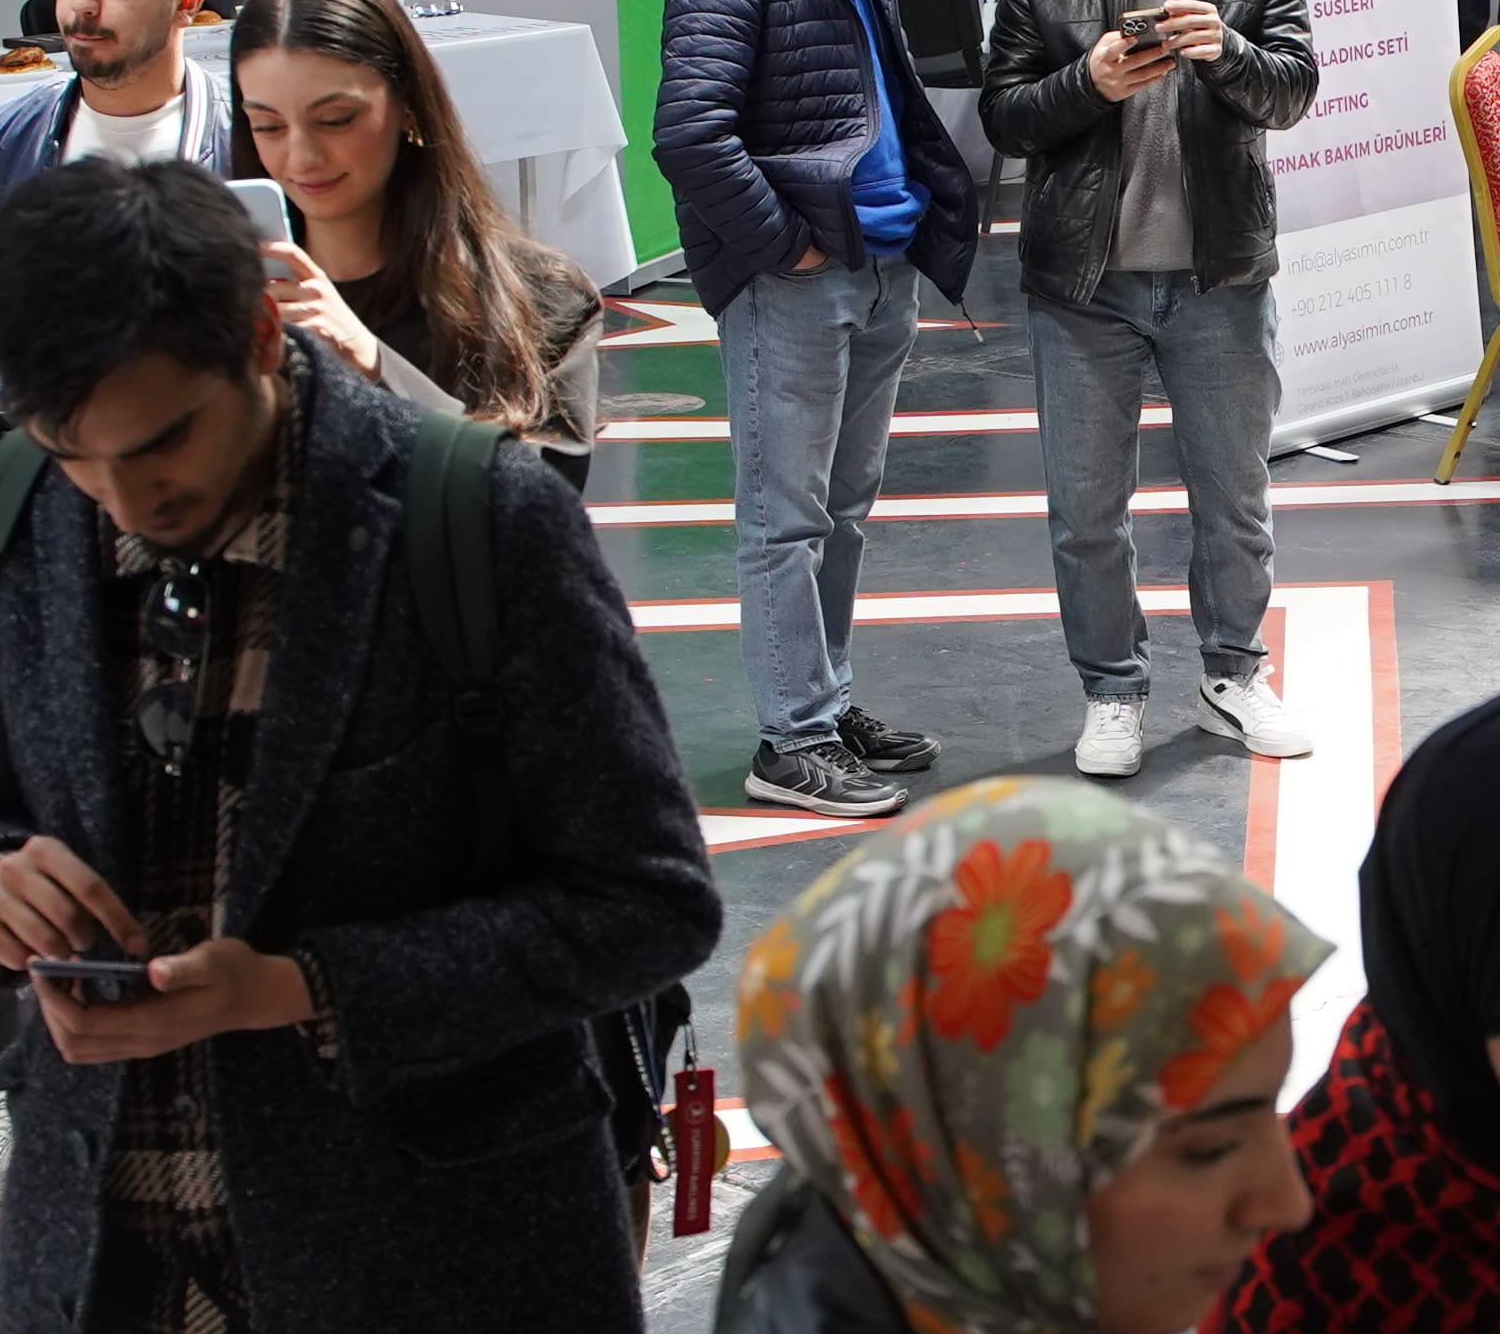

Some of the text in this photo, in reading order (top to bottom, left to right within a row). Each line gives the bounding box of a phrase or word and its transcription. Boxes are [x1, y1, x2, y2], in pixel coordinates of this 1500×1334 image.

[1377, 30, 1409, 55] SETİ
[1315, 92, 1369, 118] LIFTING
[1324, 140, 1371, 166] BAKIM
[1374, 120, 1447, 155] ÜRÜNLERİ
[1318, 290, 1343, 313] 212
[1346, 283, 1373, 306] 405
[1403, 273, 1413, 291] 8
[1293, 309, 1435, 358] www.alyasimin.com.tr
